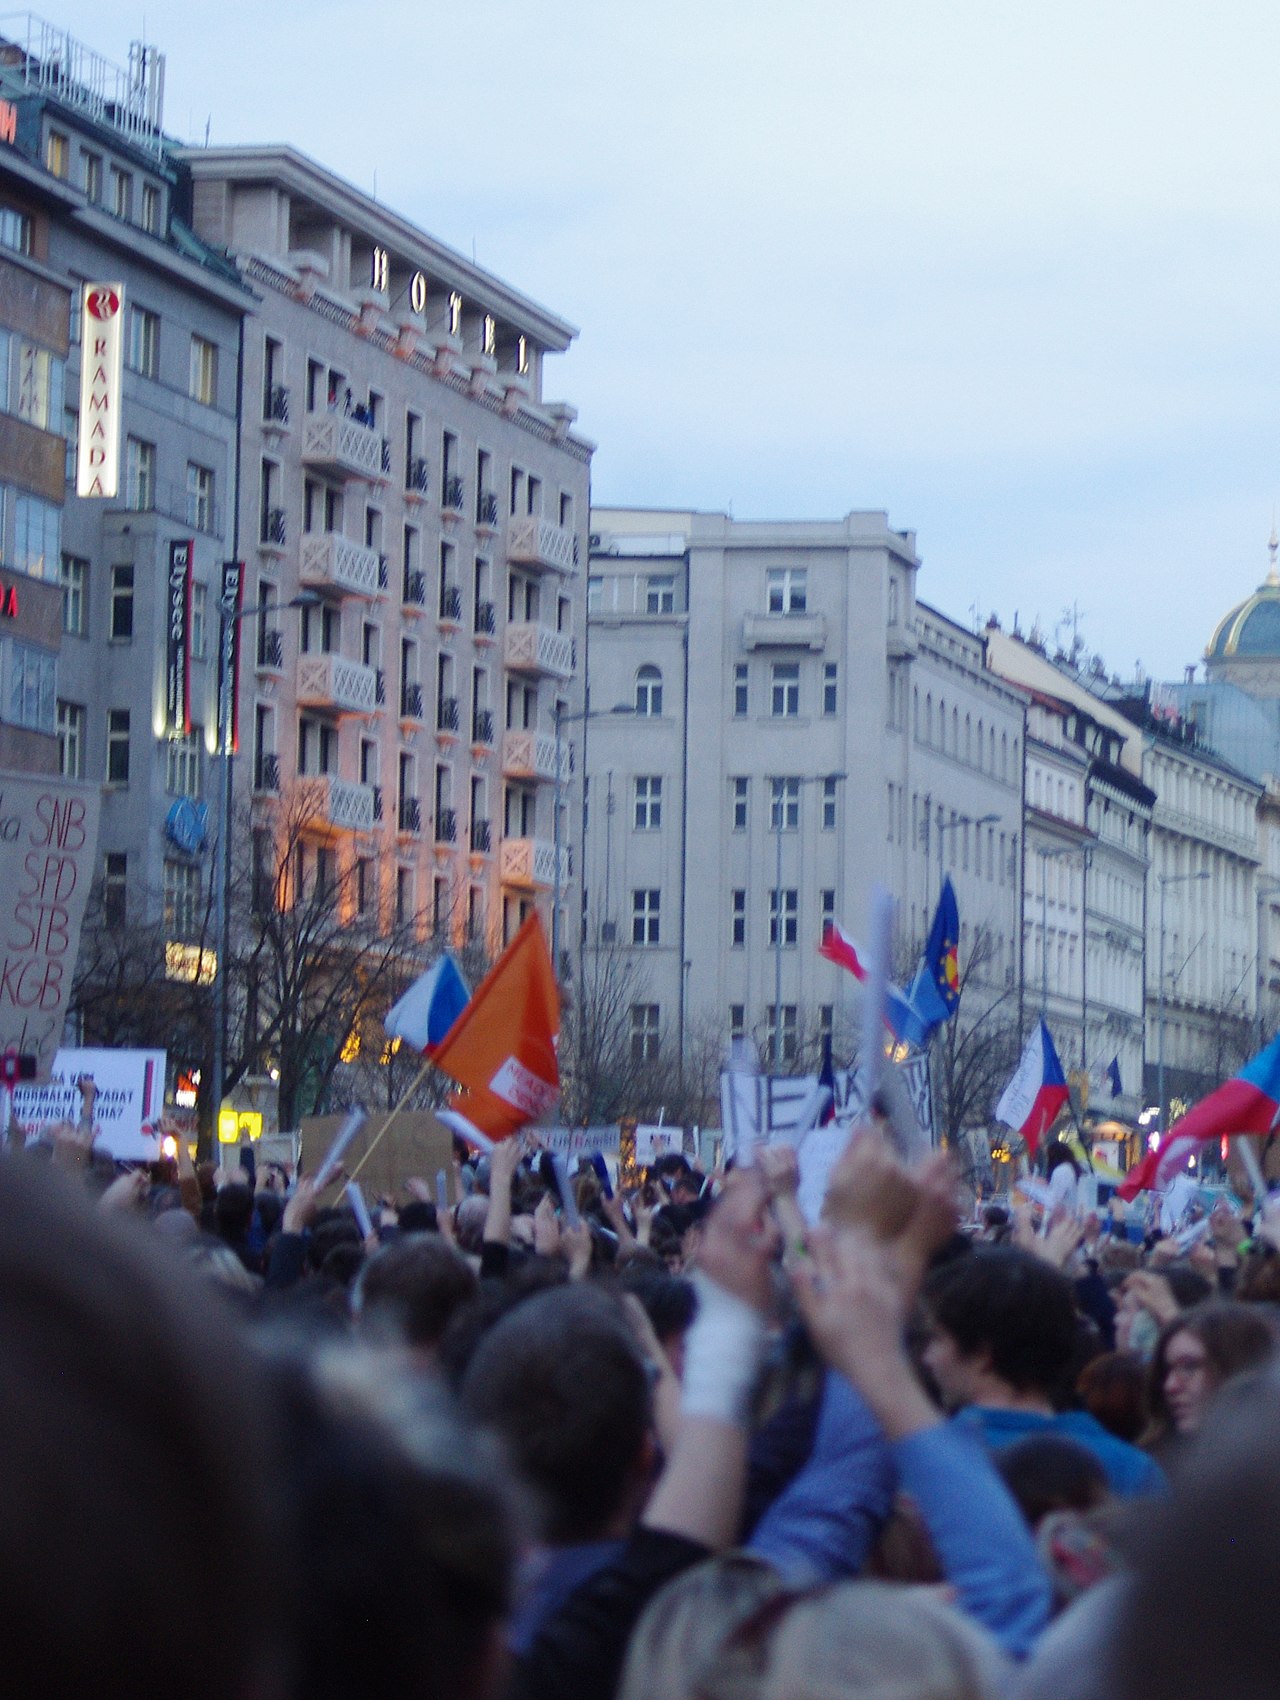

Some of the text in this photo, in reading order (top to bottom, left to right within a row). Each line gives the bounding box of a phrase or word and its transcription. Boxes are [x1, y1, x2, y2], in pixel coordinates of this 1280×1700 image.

[373, 245, 529, 374] HOTEL
[89, 338, 108, 496] RAMADA
[29, 793, 86, 851] SNB
[18, 852, 77, 901] SPD
[0, 958, 63, 1011] KGB
[14, 1085, 76, 1103] NORMÁLNÍ
